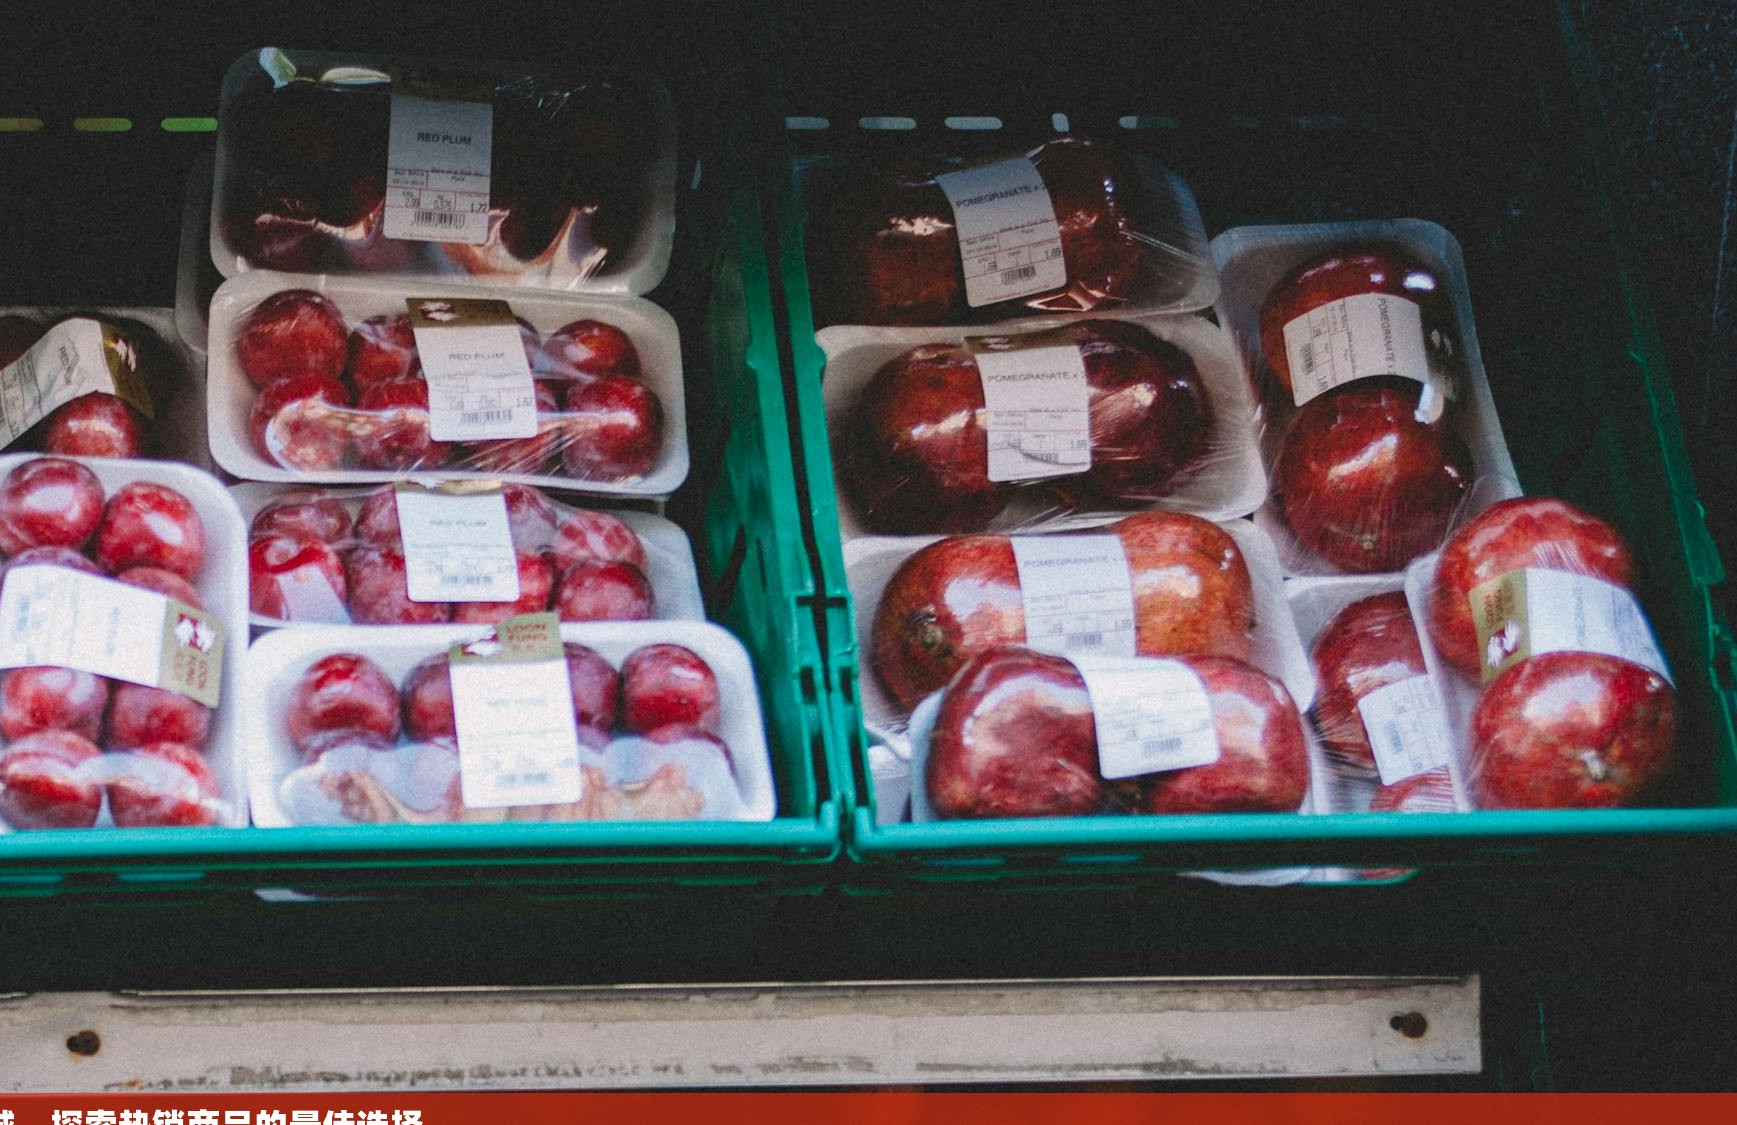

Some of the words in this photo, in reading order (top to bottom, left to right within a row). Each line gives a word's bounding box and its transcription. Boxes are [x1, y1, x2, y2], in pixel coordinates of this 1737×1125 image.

[416, 132, 440, 143] RED
[442, 133, 472, 145] PLUM
[955, 184, 1032, 209] POMEGRANATE
[470, 202, 488, 214] 1.72
[1377, 297, 1396, 362] POMEGRANATE
[474, 352, 504, 360] PLUM
[986, 371, 1069, 383] POMEGRANATE
[1024, 556, 1108, 568] POMEGRANATE
[1484, 594, 1494, 628] LOON
[1494, 589, 1503, 622] FUNG
[506, 624, 548, 634] LOON
[508, 632, 548, 642] FUNG
